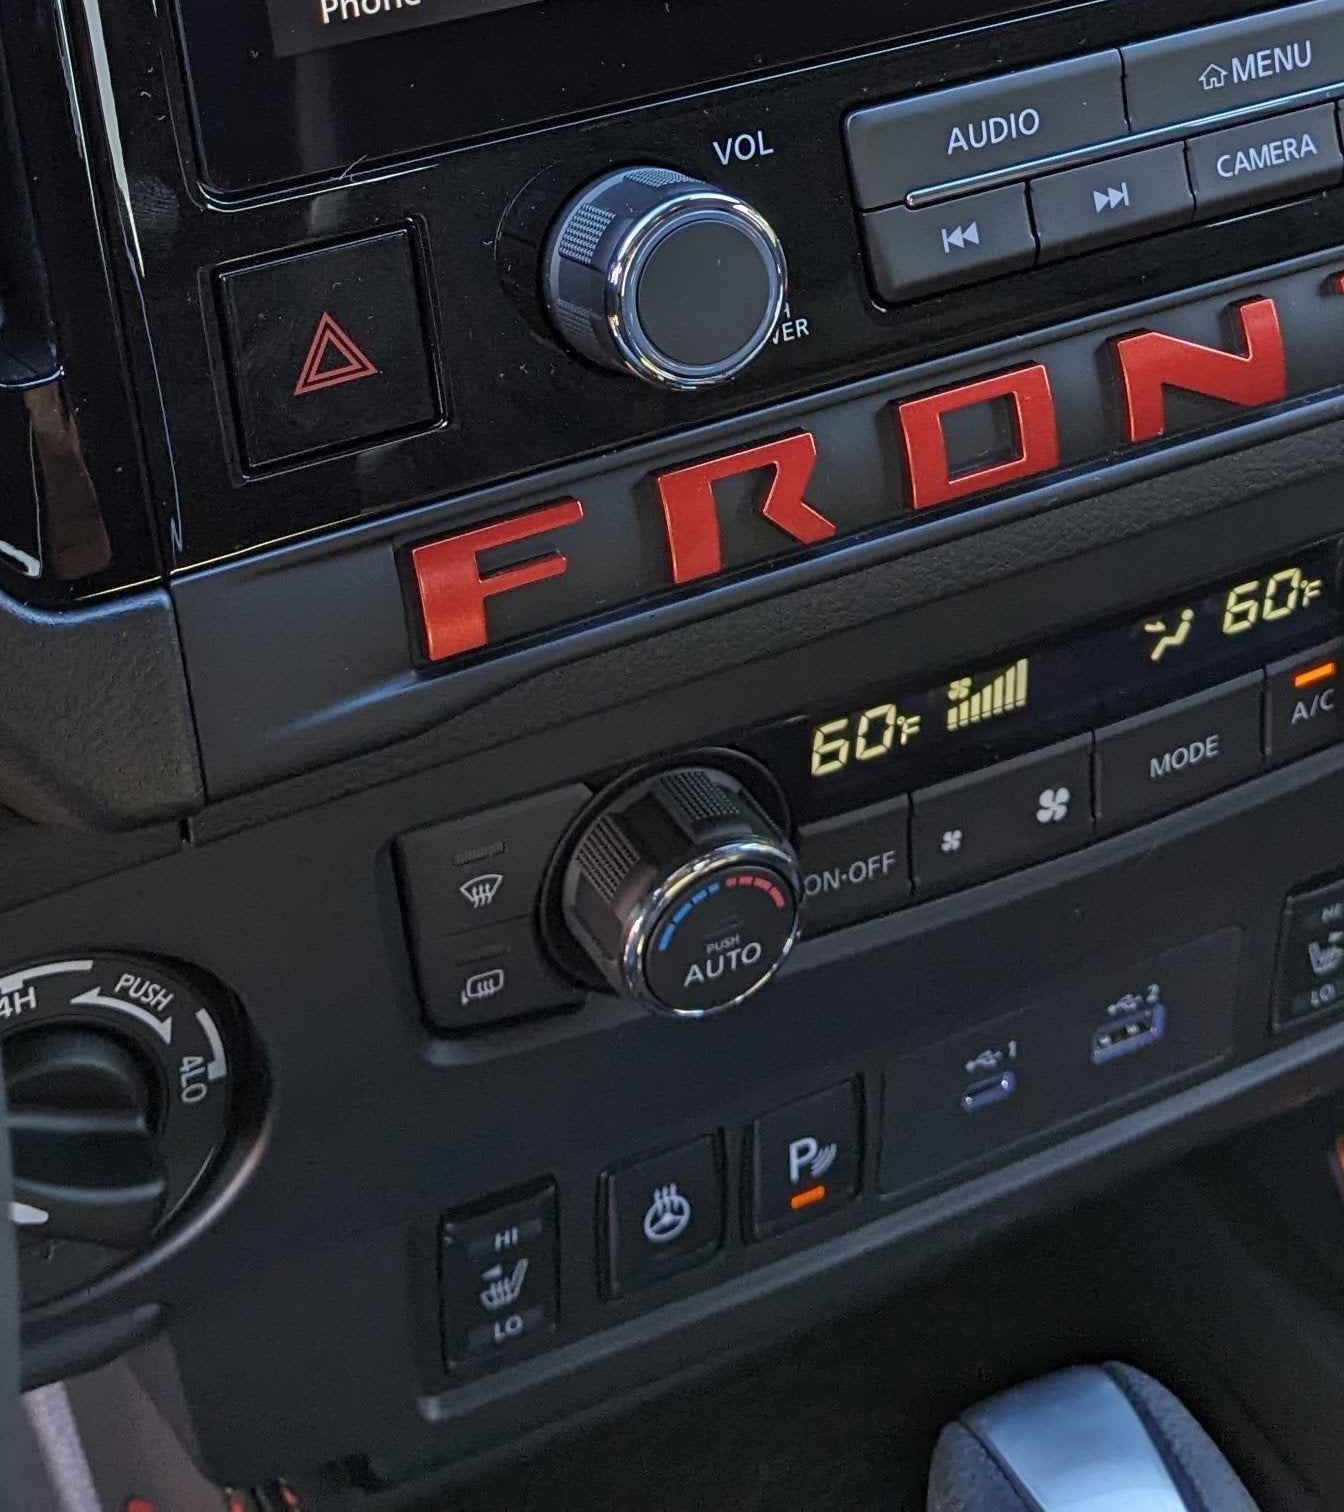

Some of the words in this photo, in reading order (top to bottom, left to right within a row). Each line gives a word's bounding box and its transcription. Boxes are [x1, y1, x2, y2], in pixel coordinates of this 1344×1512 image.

[1231, 39, 1313, 84] MENU
[712, 130, 774, 166] VOL
[946, 109, 1040, 156] AUDIO
[1215, 133, 1318, 179] CAMERA
[1290, 688, 1335, 725] A/C
[1150, 734, 1220, 780] MODE
[683, 942, 763, 987] AUTO
[707, 934, 741, 954] PUSH
[113, 972, 175, 1011] PUSH
[180, 1055, 208, 1103] 4LO
[494, 1227, 520, 1251] HI
[494, 1314, 524, 1342] LO
